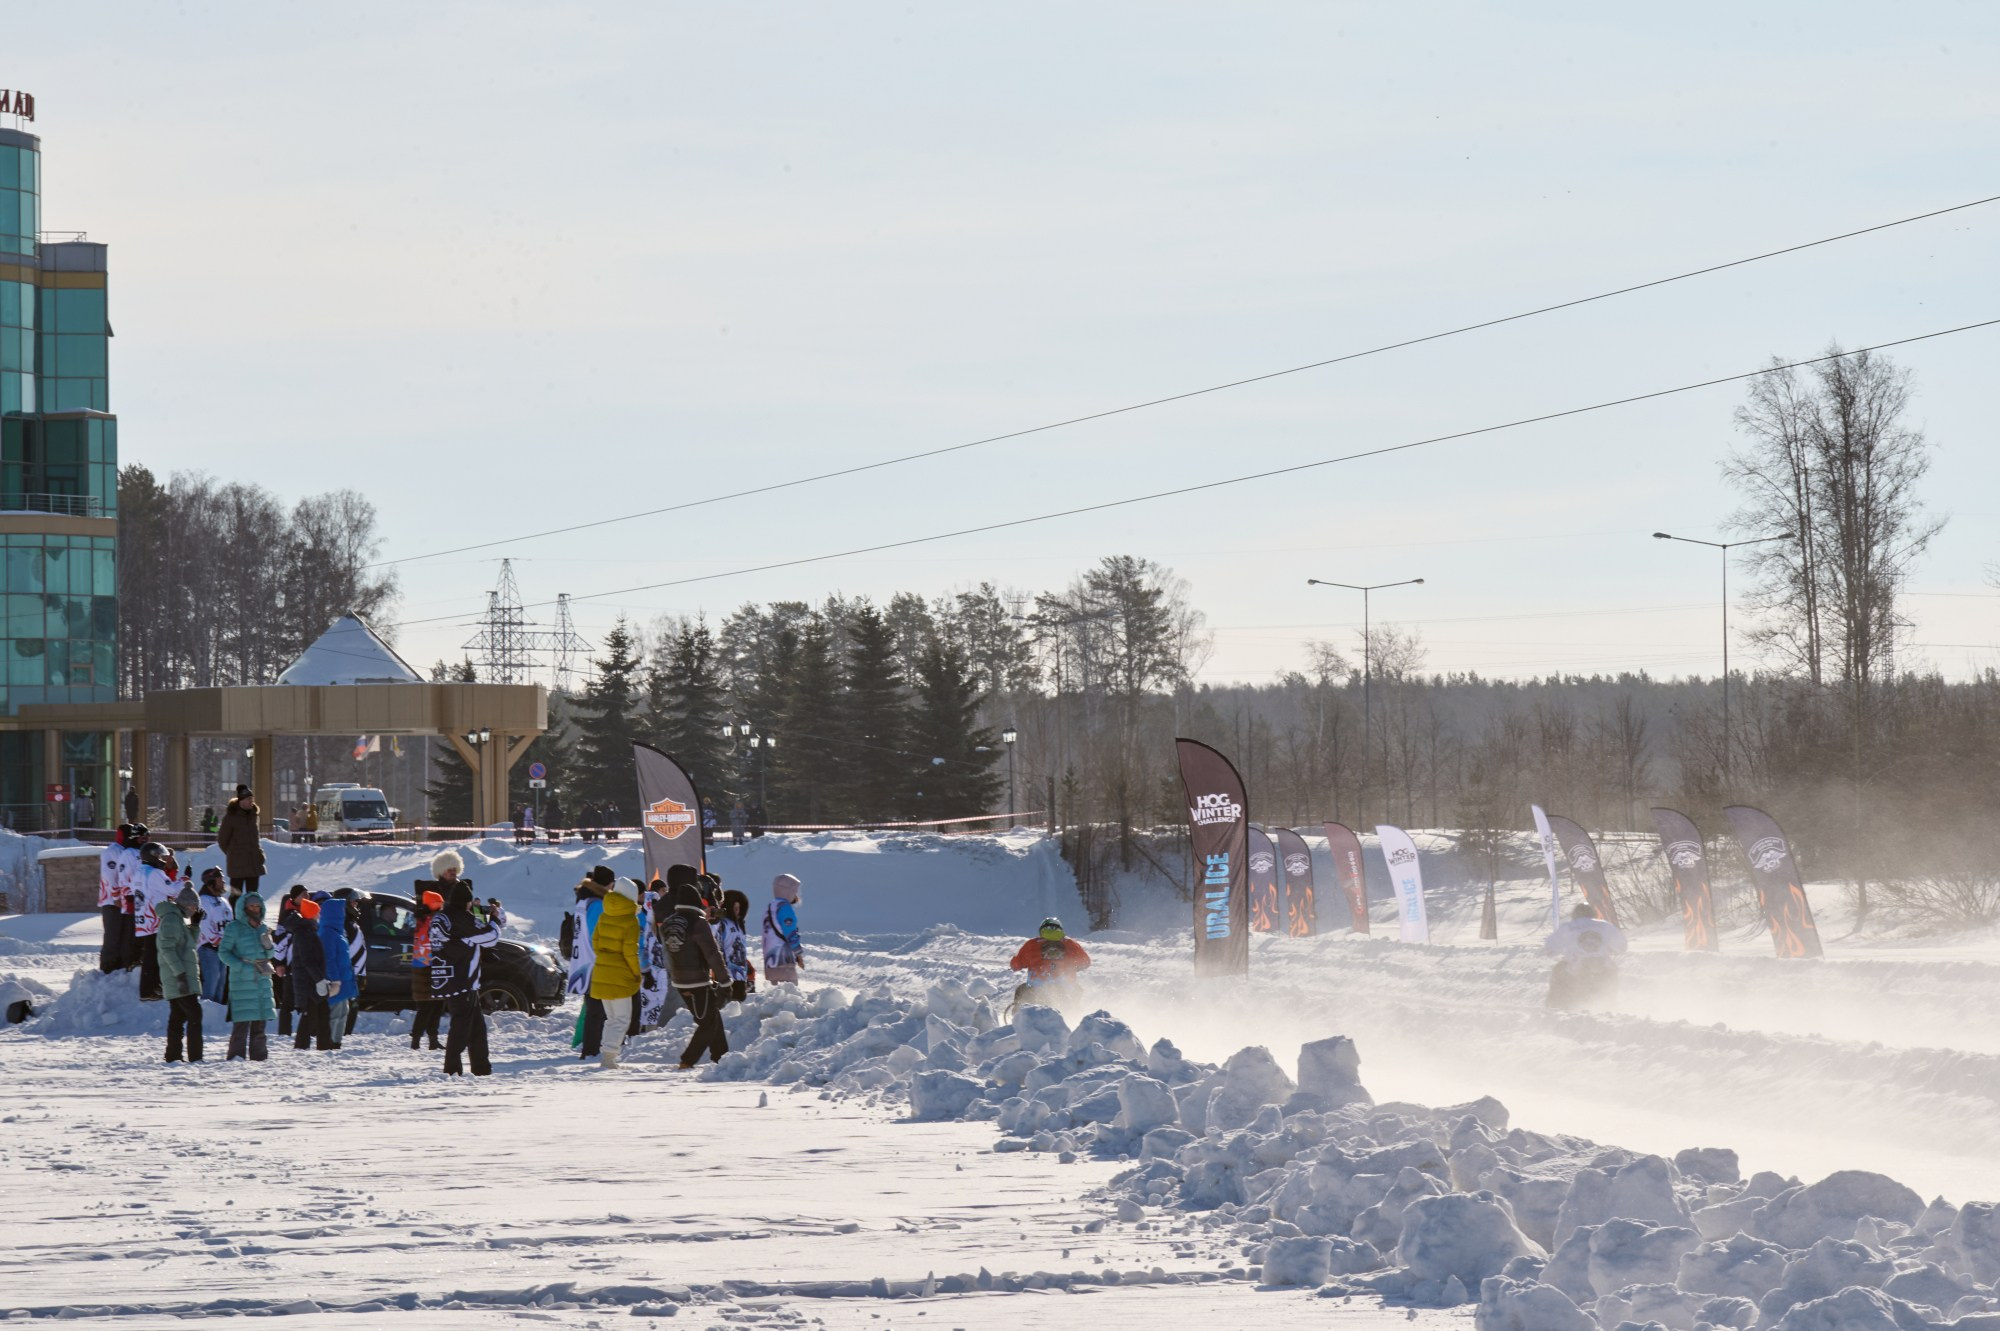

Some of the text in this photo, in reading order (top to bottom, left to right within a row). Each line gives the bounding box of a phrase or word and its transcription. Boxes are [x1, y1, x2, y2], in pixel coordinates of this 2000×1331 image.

[1190, 803, 1242, 821] WINTER
[1198, 817, 1236, 825] CHALLENGE
[1388, 853, 1416, 865] WINTER
[1204, 852, 1231, 939] URAL ICE
